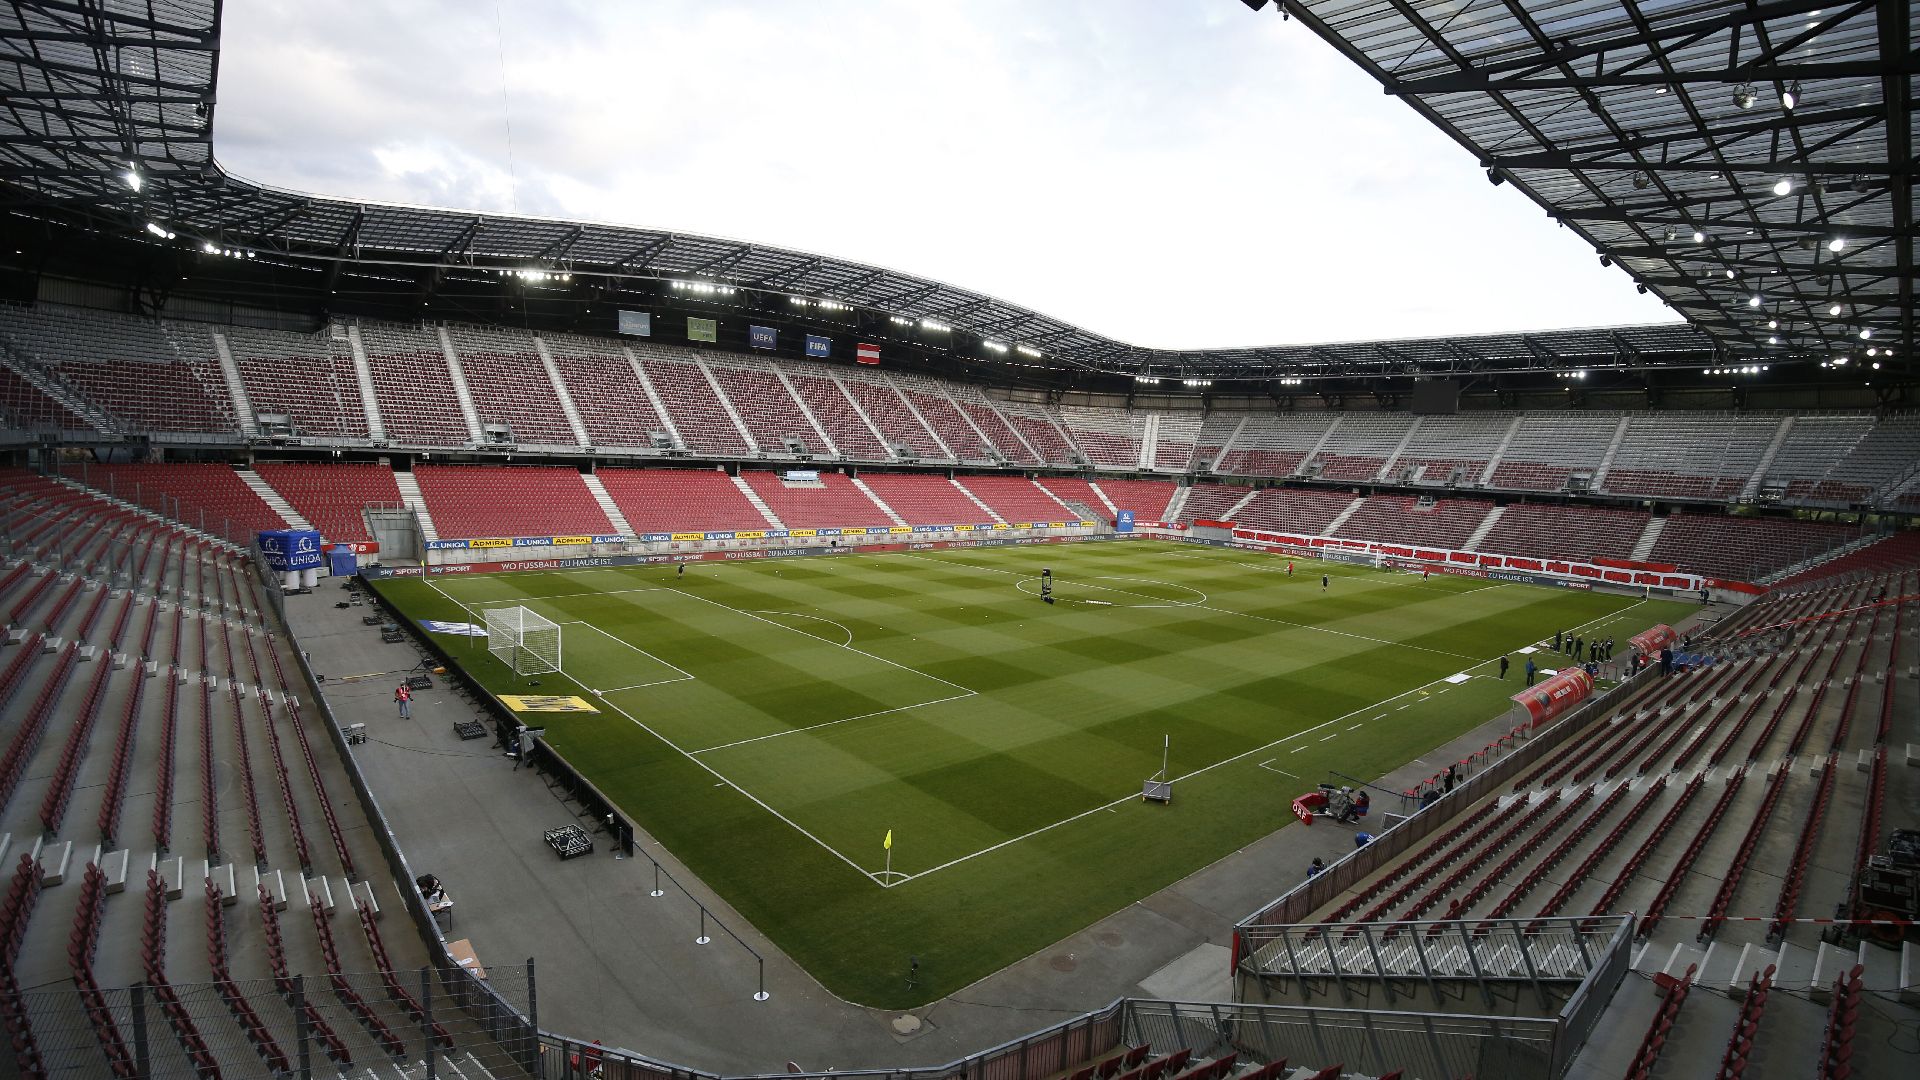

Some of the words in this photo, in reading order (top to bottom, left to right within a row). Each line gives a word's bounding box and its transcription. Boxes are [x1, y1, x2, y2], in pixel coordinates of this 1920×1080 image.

[753, 333, 773, 343] UEFA
[809, 342, 827, 351] FIFA
[291, 554, 320, 566] UNIQA
[518, 561, 558, 569] FUSSBALL
[1456, 568, 1487, 578] FUSSBALL
[1499, 574, 1521, 582] HAUSE
[1292, 803, 1306, 820] ORF
